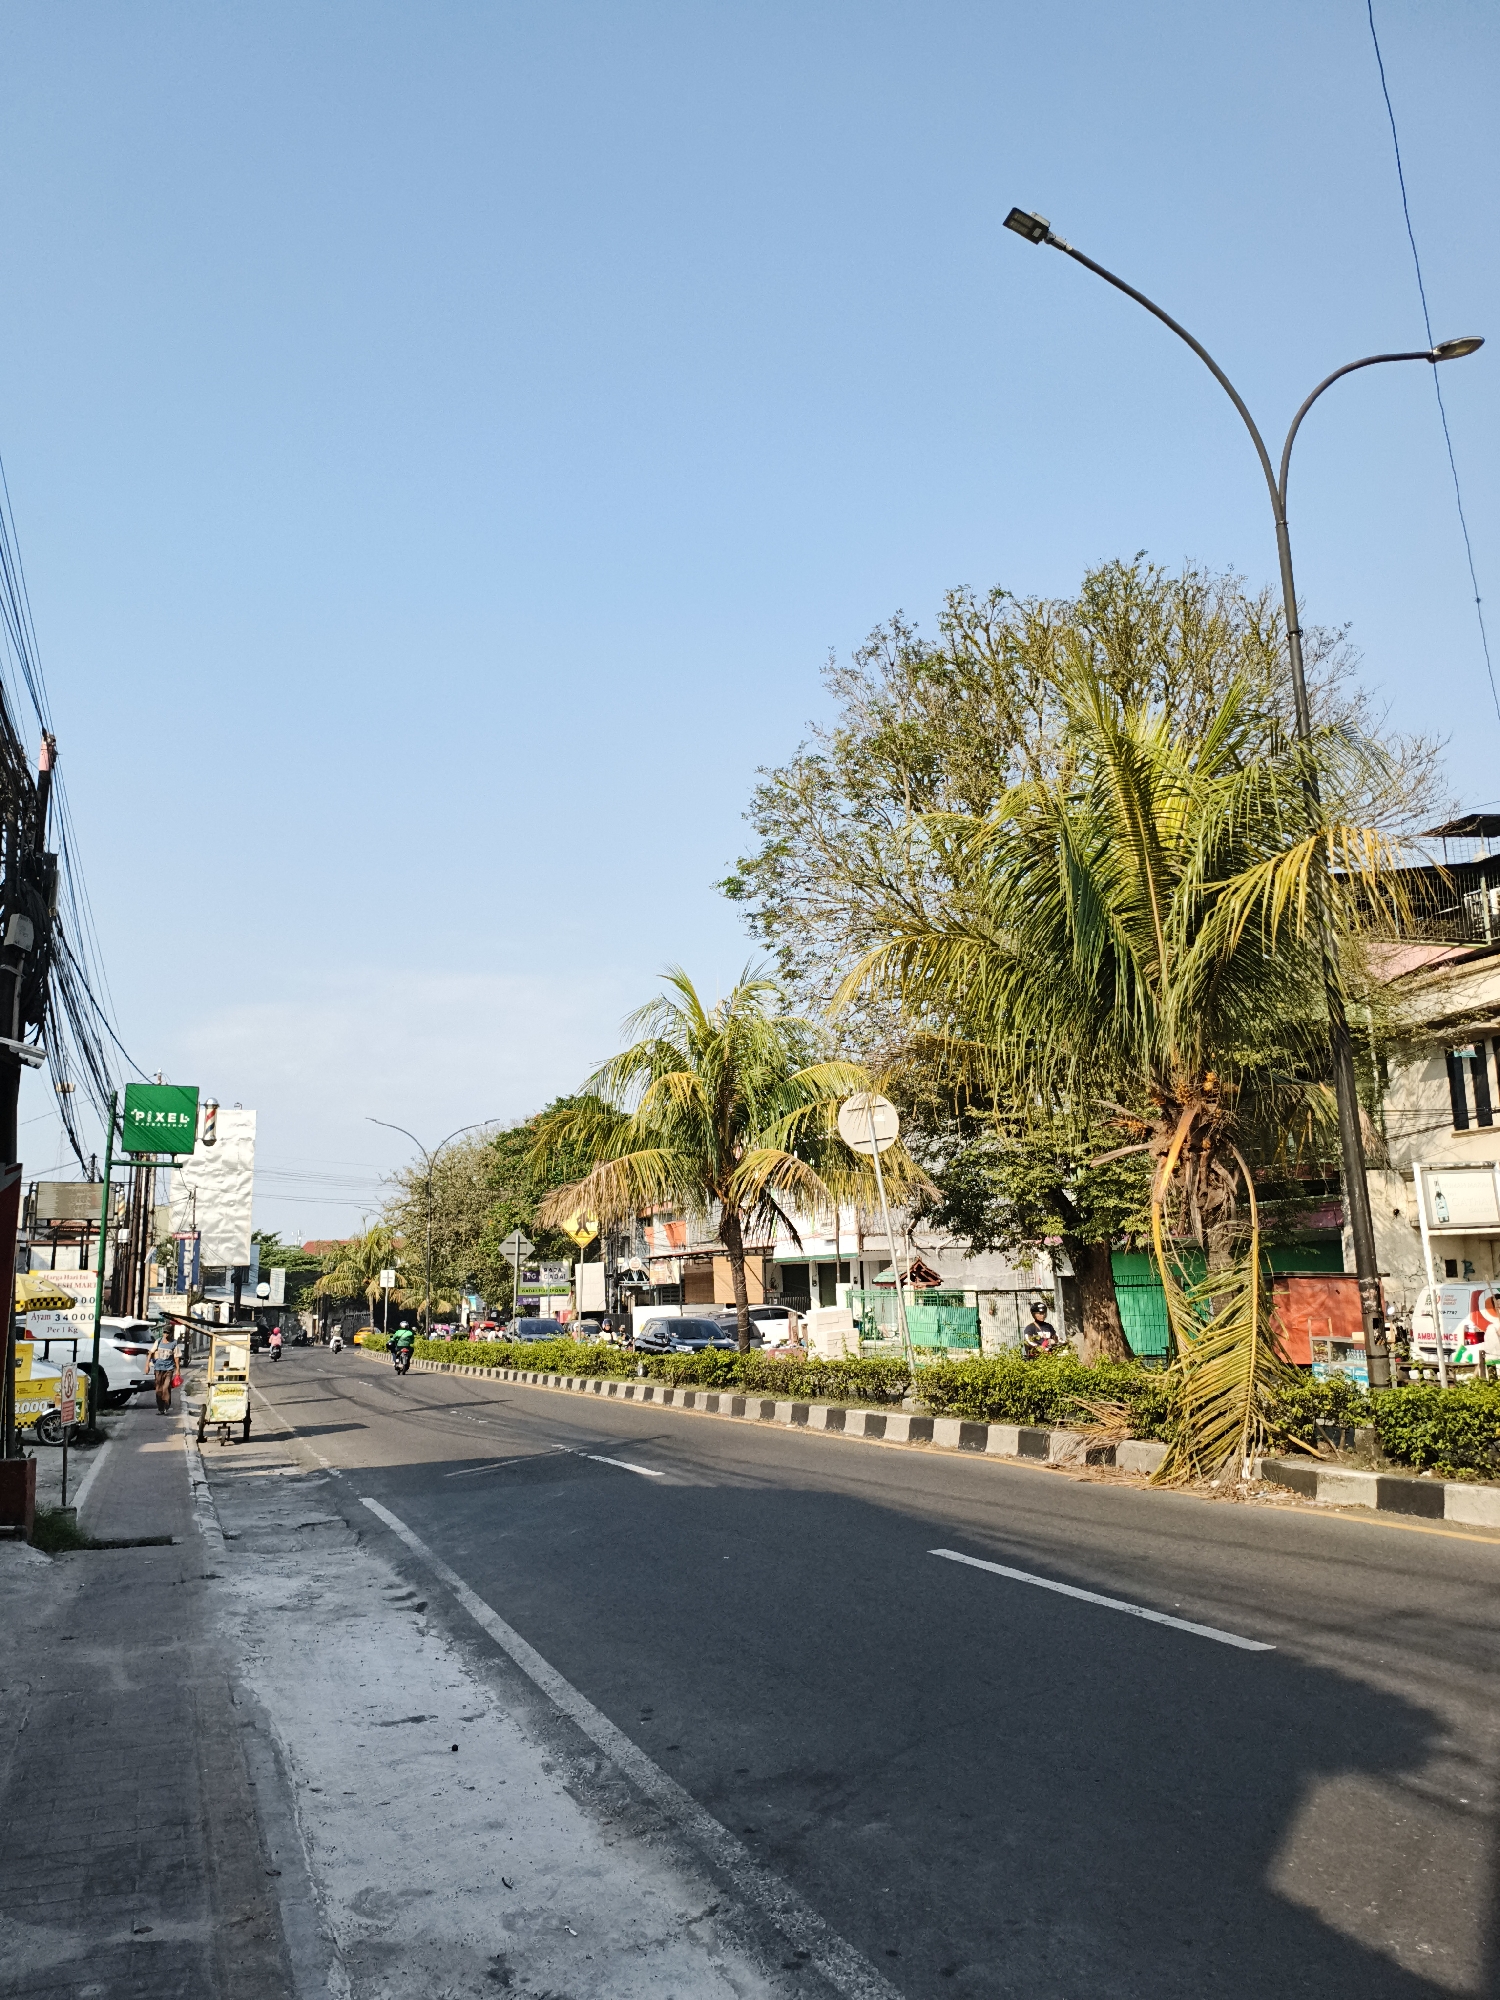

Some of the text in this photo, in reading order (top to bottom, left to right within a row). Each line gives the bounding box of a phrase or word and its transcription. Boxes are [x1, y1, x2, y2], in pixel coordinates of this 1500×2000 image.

[131, 1109, 190, 1123] PIXEL
[43, 1274, 63, 1282] Harga
[31, 1312, 52, 1323] Ayam
[1417, 1332, 1459, 1341] AMBUNCE
